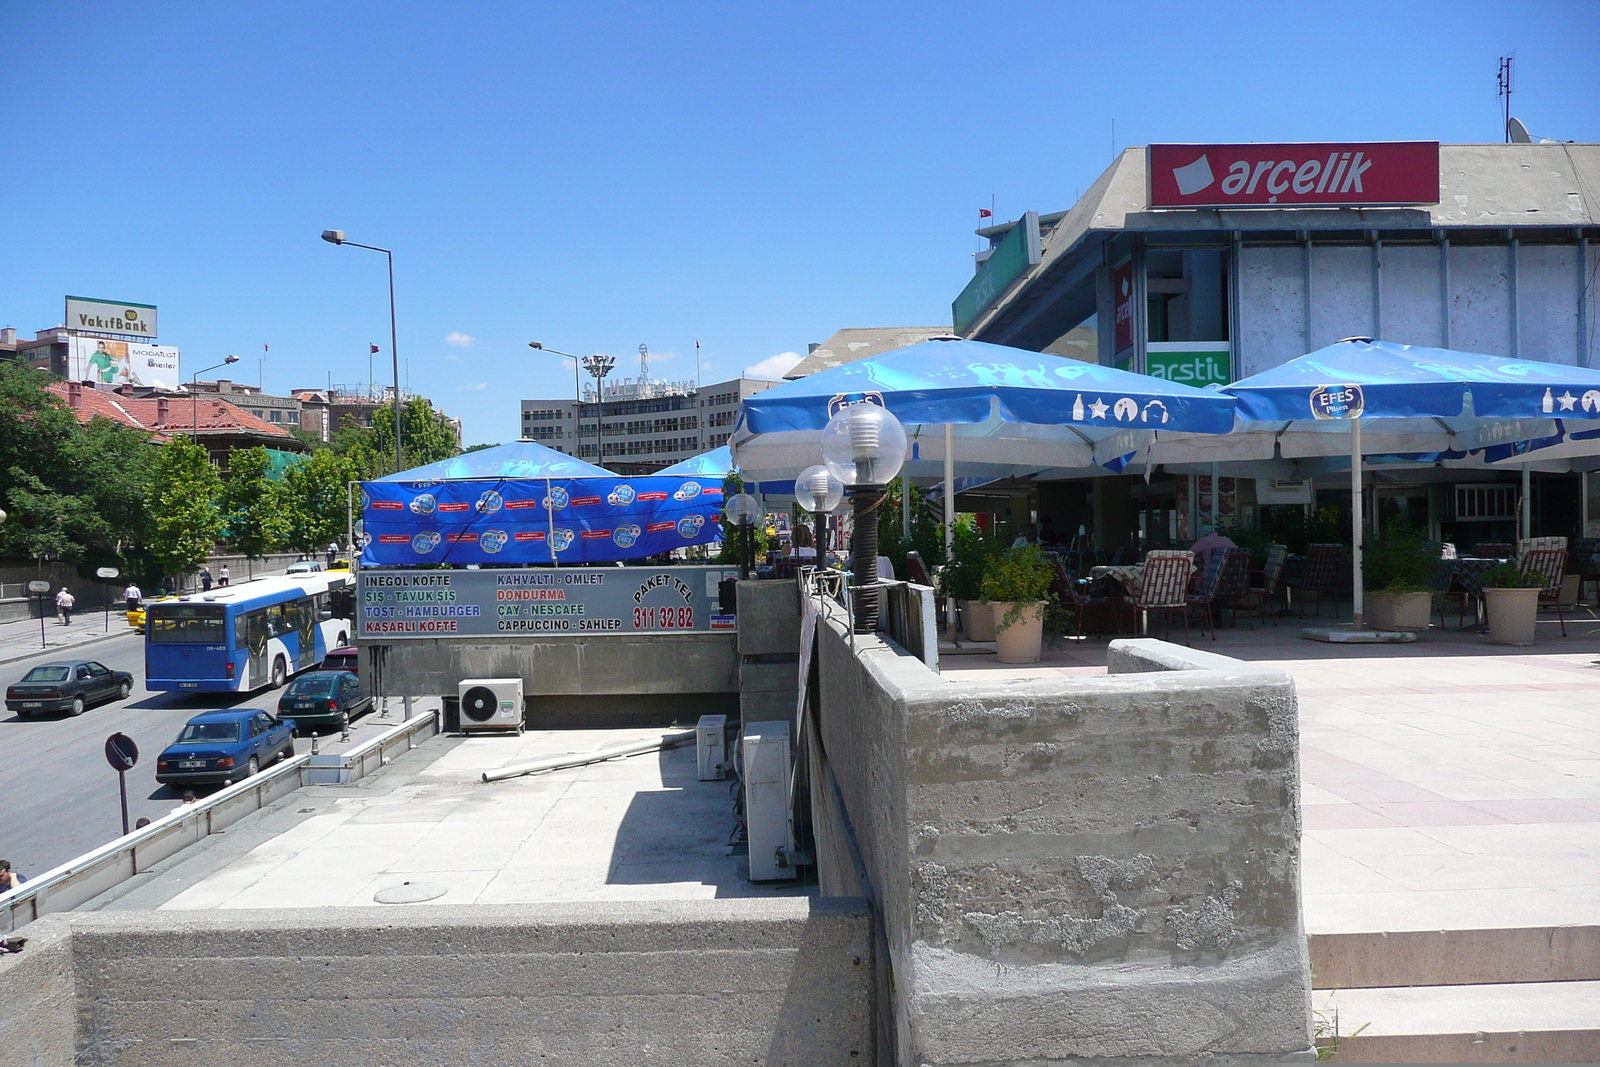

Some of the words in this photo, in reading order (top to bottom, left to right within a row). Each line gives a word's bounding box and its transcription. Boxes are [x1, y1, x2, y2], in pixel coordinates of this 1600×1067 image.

[1222, 152, 1372, 204] arçelik
[79, 314, 148, 332] VakıfBank
[1151, 357, 1226, 380] arstil
[1320, 388, 1354, 406] EFES
[1326, 404, 1348, 414] Pilsen
[366, 573, 408, 586] İNEGÖL
[412, 572, 450, 586] KÖFTE
[497, 574, 554, 586] KAHVALTI
[564, 574, 604, 585] OMLET
[366, 588, 384, 605] ŞİŞ
[395, 590, 434, 602] TAVUK
[437, 588, 456, 604] ŞİŞ
[497, 589, 566, 600] DONDURMA
[633, 574, 672, 604] PAKET
[674, 577, 693, 605] TEL
[366, 606, 396, 617] TOST
[406, 606, 480, 616] HAMBURGER
[497, 604, 520, 618] ÇAY
[531, 604, 584, 615] NESCAFE
[633, 607, 656, 628] 311
[660, 606, 675, 628] 32
[678, 606, 694, 628] 82
[366, 622, 416, 634] KAŞARLI
[420, 618, 458, 632] KÖFTE
[498, 620, 569, 631] CAPPUCCINO
[580, 618, 622, 630] SAHLEP
